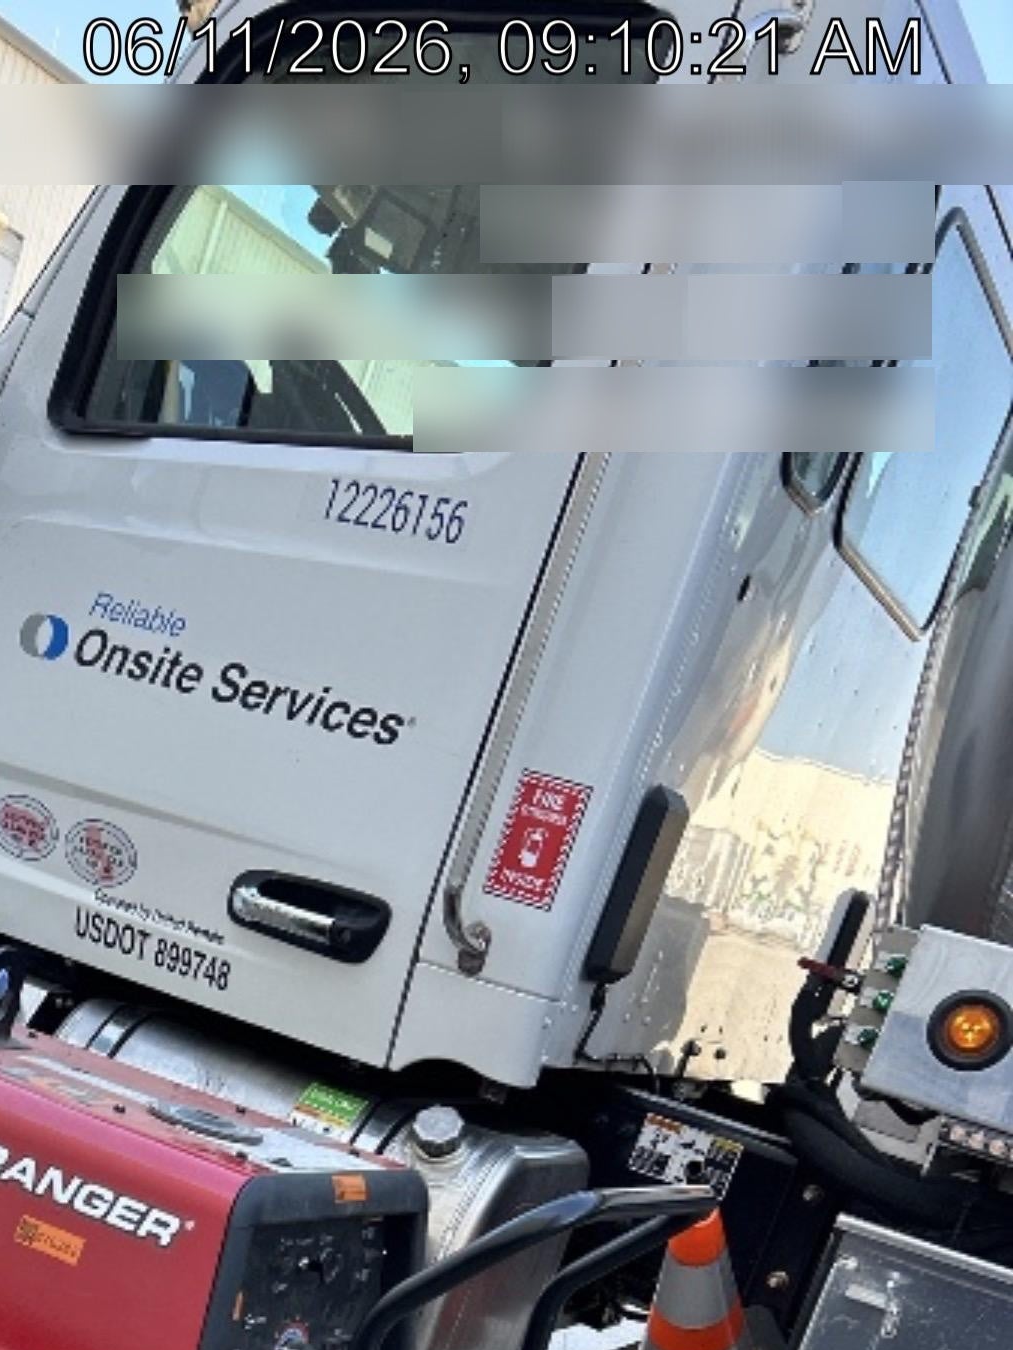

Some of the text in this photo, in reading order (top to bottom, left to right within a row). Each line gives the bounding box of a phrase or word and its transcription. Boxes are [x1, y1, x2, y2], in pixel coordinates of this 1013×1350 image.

[324, 478, 468, 544] 12226156
[89, 593, 187, 637] Reliable
[73, 629, 405, 745] Onsite Services
[75, 906, 231, 992] USDOT 899748
